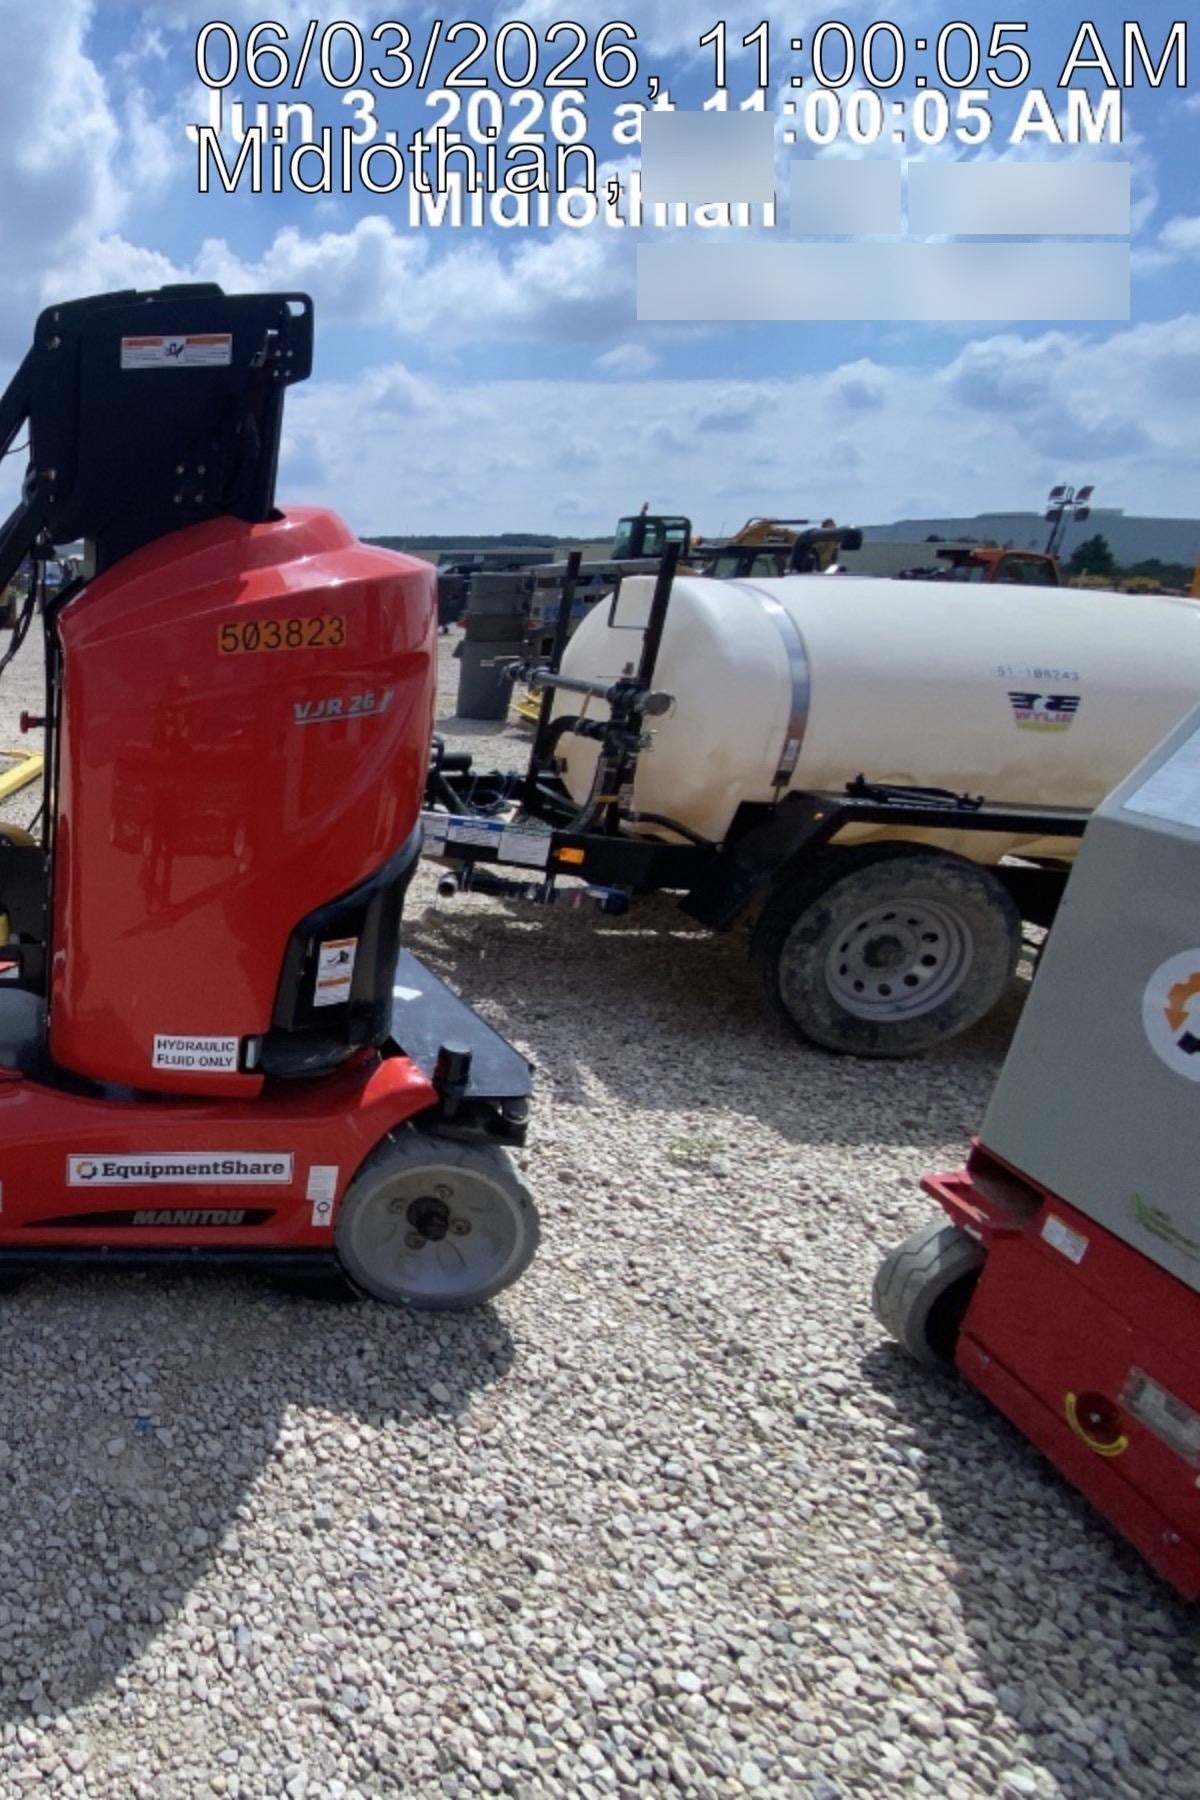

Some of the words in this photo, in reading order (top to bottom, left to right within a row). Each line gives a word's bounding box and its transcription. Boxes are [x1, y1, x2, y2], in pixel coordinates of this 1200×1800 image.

[221, 616, 345, 652] 503823
[294, 698, 343, 720] VJR
[157, 1039, 235, 1053] HYDRAULIC
[157, 1053, 195, 1066] FLUID
[199, 1056, 233, 1067] ONLY
[102, 1160, 285, 1179] EquipmentShare
[132, 1209, 246, 1225] MANITOU
